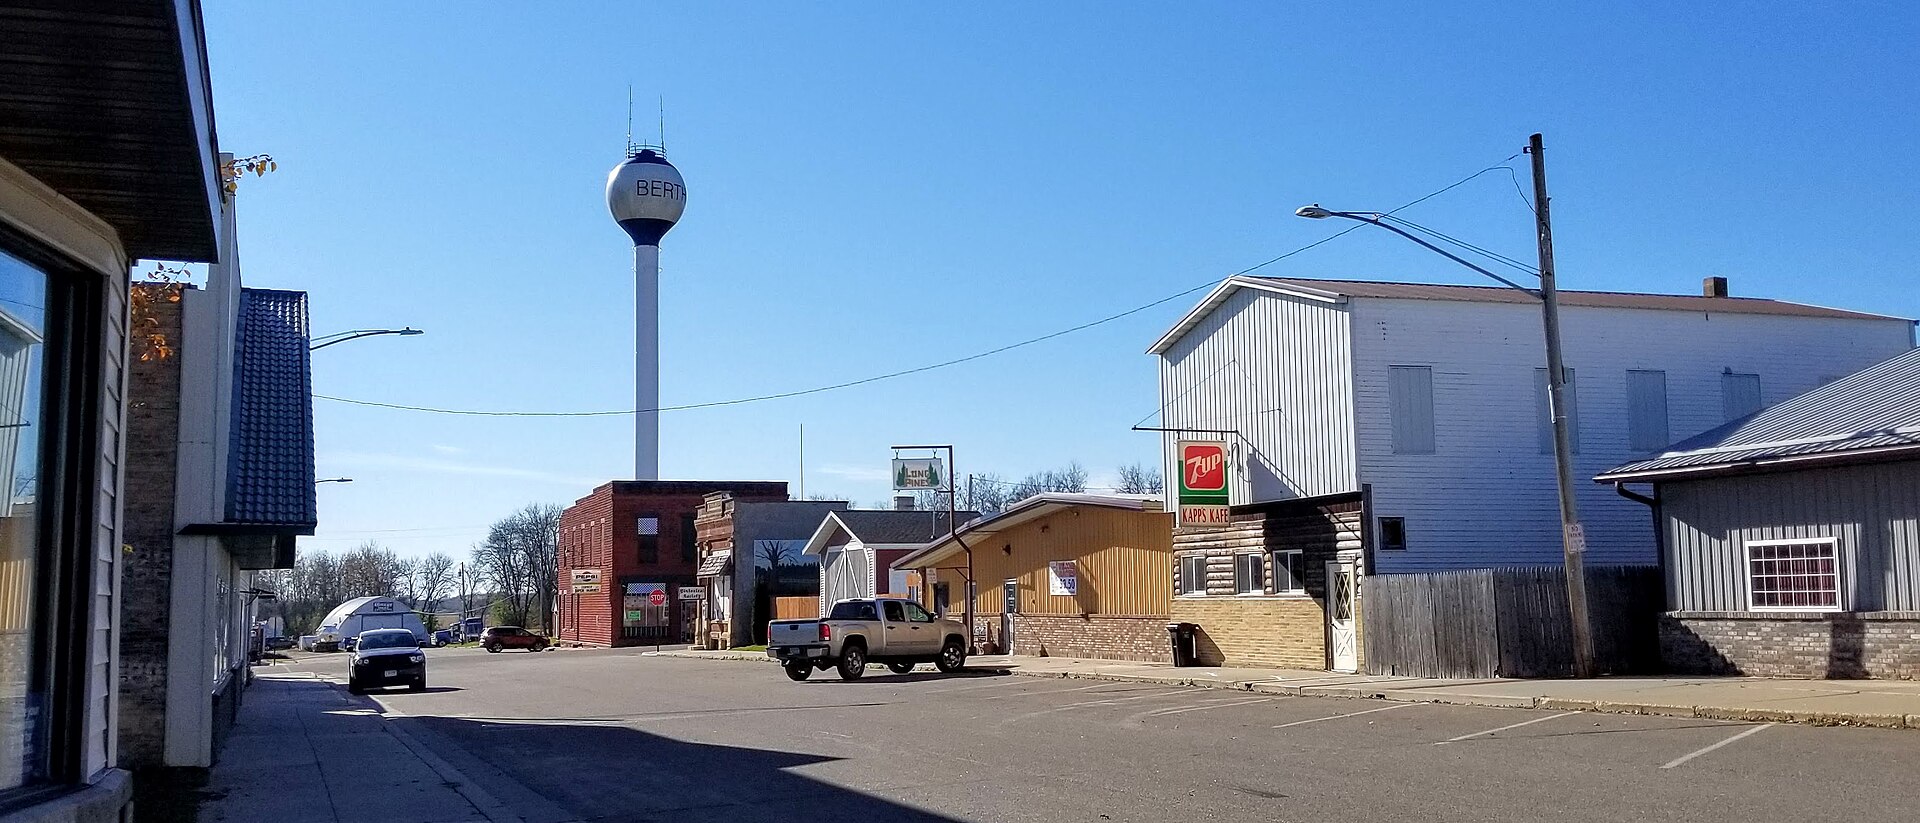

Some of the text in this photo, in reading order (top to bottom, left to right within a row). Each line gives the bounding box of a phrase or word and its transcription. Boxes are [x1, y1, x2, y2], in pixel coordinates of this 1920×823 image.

[905, 468, 931, 479] LONG
[1186, 453, 1221, 485] 7UP
[905, 479, 931, 487] PINES
[1182, 507, 1229, 523] KAPP'S KAFE
